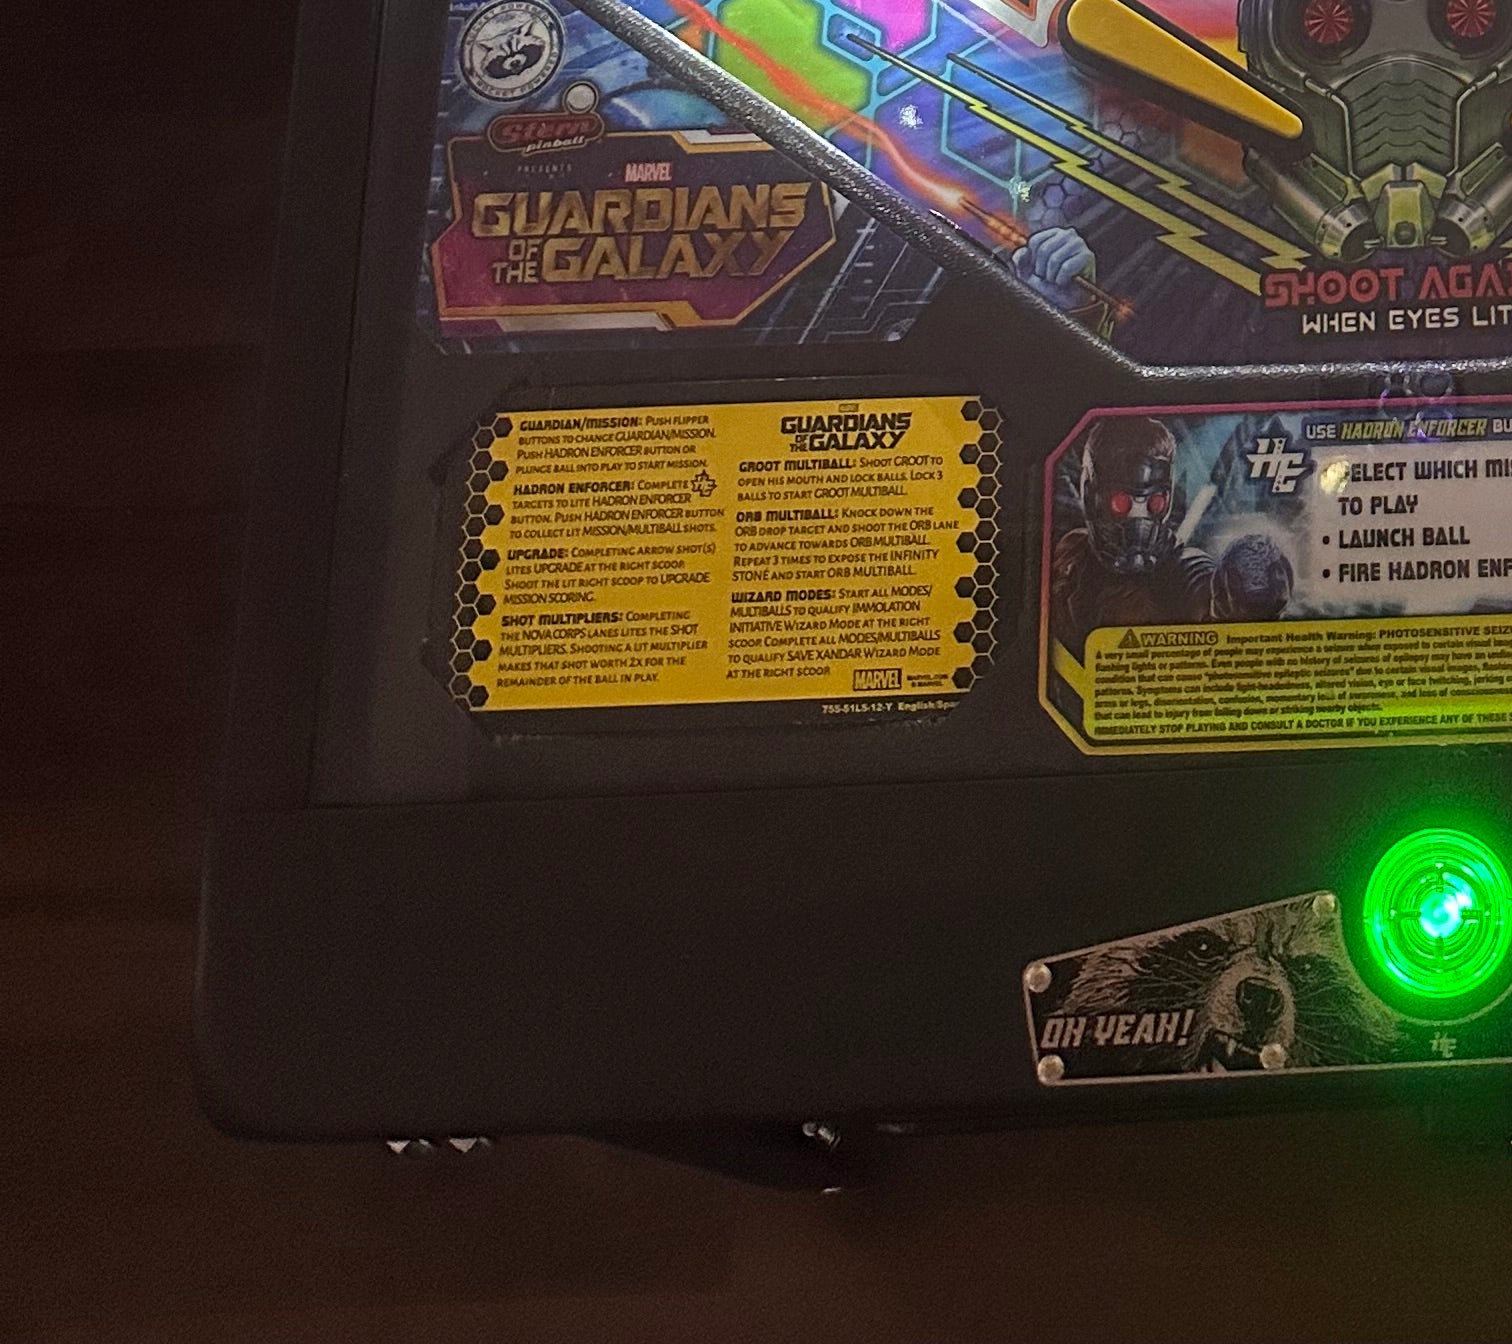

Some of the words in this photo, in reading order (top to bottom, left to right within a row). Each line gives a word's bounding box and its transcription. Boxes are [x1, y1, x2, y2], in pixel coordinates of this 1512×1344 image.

[525, 134, 585, 154] pinball
[624, 162, 673, 182] MARVEL
[471, 181, 812, 237] GUARDIANS
[508, 238, 543, 262] OF
[541, 229, 795, 283] GALAXY
[492, 261, 538, 284] THE
[1263, 266, 1405, 308] SHOOT
[1301, 312, 1377, 335] WHEN
[1388, 307, 1460, 331] EYES
[780, 412, 913, 434] GUARDIANS
[1305, 423, 1337, 440] USE
[1340, 418, 1405, 440] HADRON
[1407, 416, 1488, 439] ENFORCER
[809, 431, 907, 451] GALAXY
[739, 461, 781, 473] GROOT
[783, 458, 857, 471] MULTIBALL:
[1340, 462, 1408, 483] ELECT
[1414, 459, 1479, 481] WHICH
[513, 483, 564, 496] HADRON
[736, 511, 761, 523] ORB
[765, 508, 839, 522] MULTIBALL:
[1337, 496, 1362, 516] TO
[1370, 493, 1419, 515] PLAY
[1338, 527, 1414, 550] LAUNCH
[1422, 525, 1470, 547] BALL
[1338, 561, 1380, 584] FIRE
[1387, 558, 1470, 582] HADRON
[731, 591, 781, 603] WIZARD
[785, 589, 837, 601] MODES:
[502, 614, 535, 627] SHOT
[1141, 631, 1218, 648] WARNING
[1285, 631, 1324, 643] Health
[1379, 626, 1481, 639] PHOTOSENSITIVE
[853, 668, 902, 691] MARVEL
[1039, 1012, 1086, 1048] OH
[1094, 1007, 1197, 1048] YEAH!
